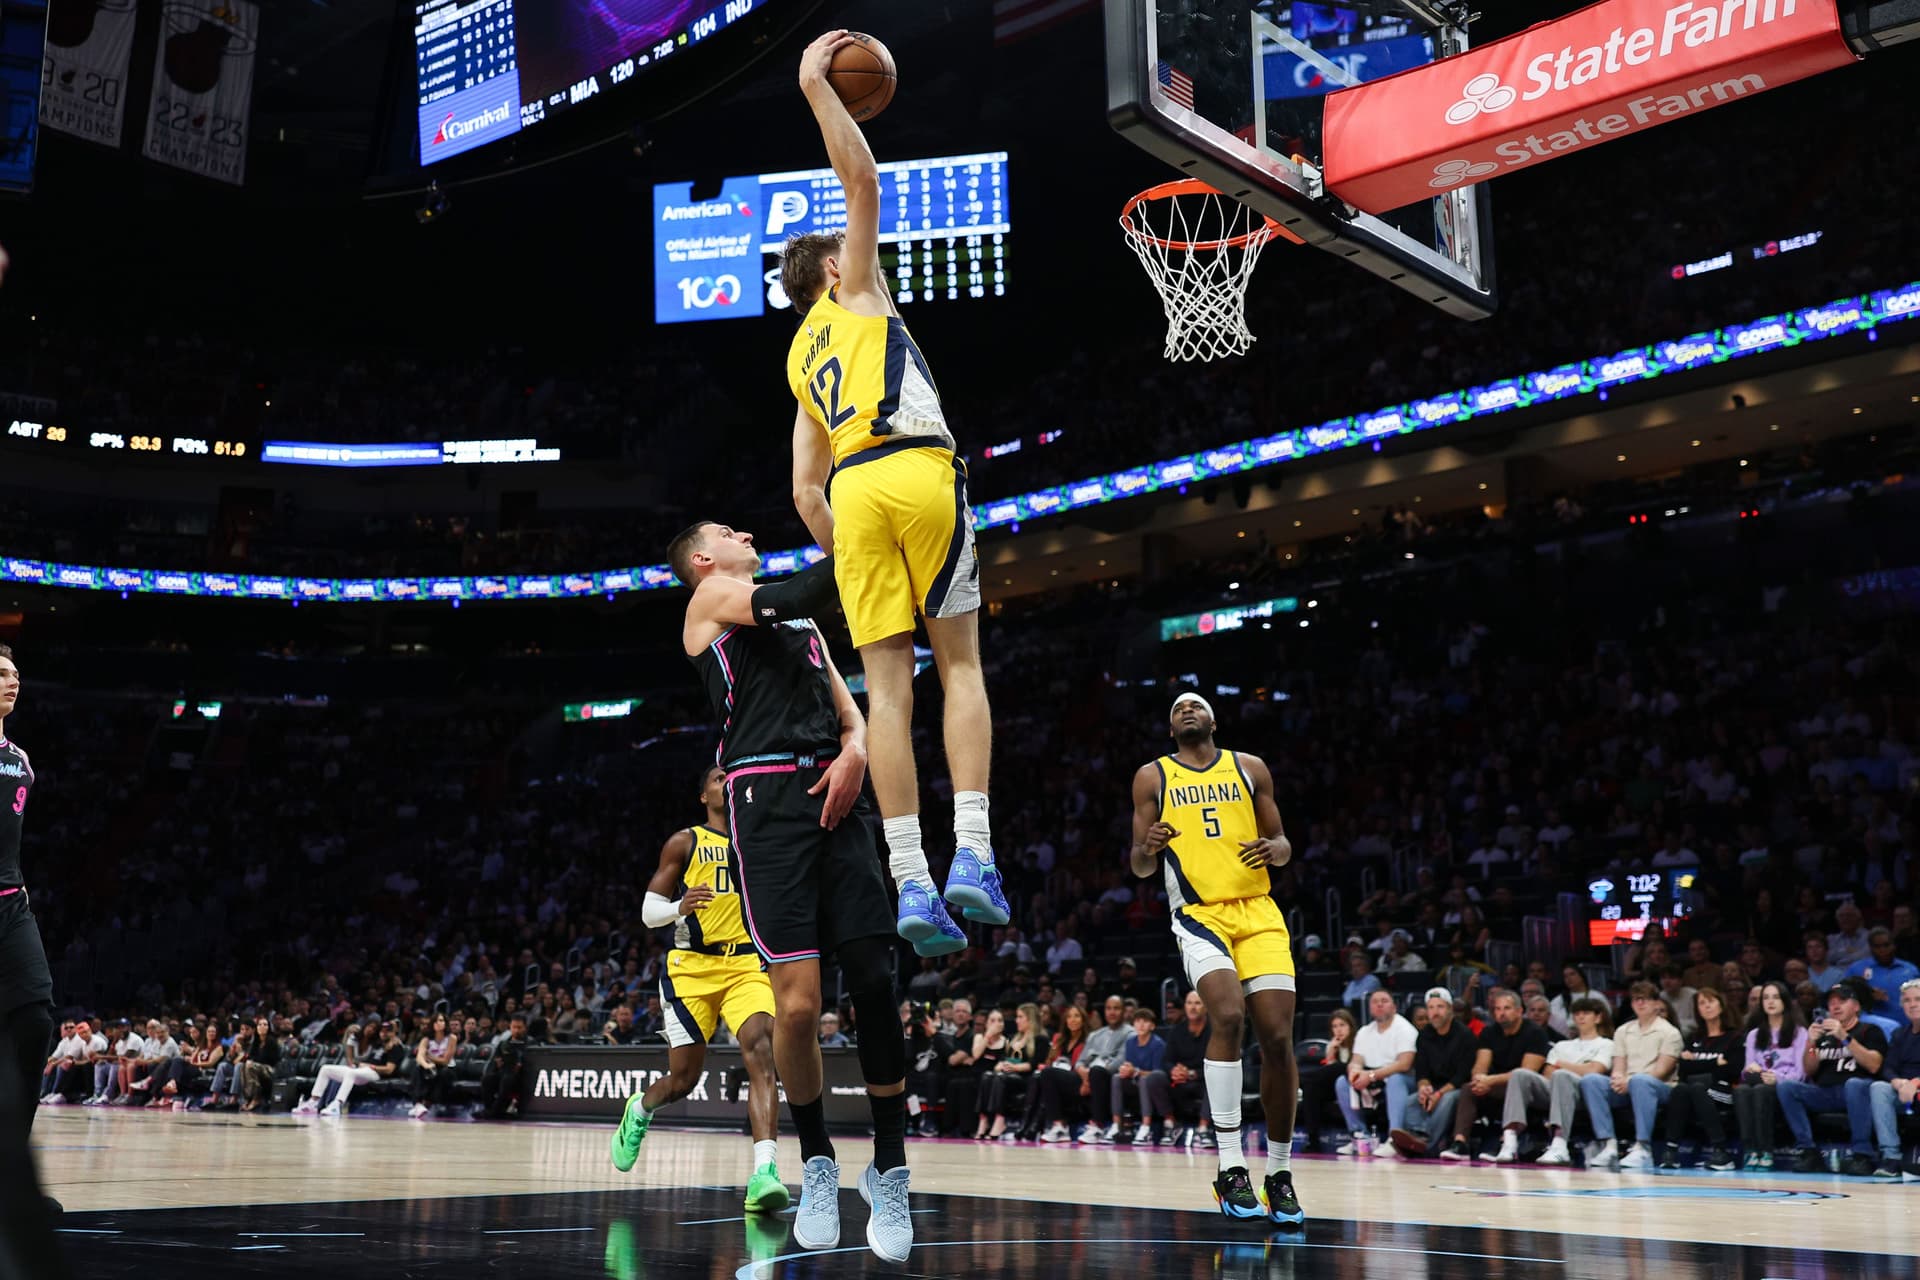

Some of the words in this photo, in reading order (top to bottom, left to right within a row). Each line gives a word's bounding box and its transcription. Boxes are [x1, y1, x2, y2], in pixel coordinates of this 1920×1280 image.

[570, 76, 599, 105] MIA
[610, 59, 634, 84] 120
[653, 39, 675, 60] 7:02
[692, 13, 716, 40] 104
[725, 0, 752, 23] IND
[83, 72, 119, 108] 20
[40, 103, 115, 139] AMPIONS
[156, 95, 189, 132] 22
[211, 116, 242, 147] 23
[448, 100, 510, 139] Carnival
[150, 140, 240, 178] CHAMPIONS
[662, 202, 732, 221] American
[677, 274, 741, 310] 100
[809, 356, 857, 431] 12
[8, 421, 42, 438] AST
[130, 435, 162, 451] 33.3
[173, 438, 208, 454] FG%
[12, 786, 27, 813] 9
[1169, 782, 1242, 807] INDIANA
[1202, 807, 1221, 838] 5
[715, 866, 730, 894] 0
[1836, 1058, 1857, 1072] 14
[534, 1069, 646, 1099] AMERANT
